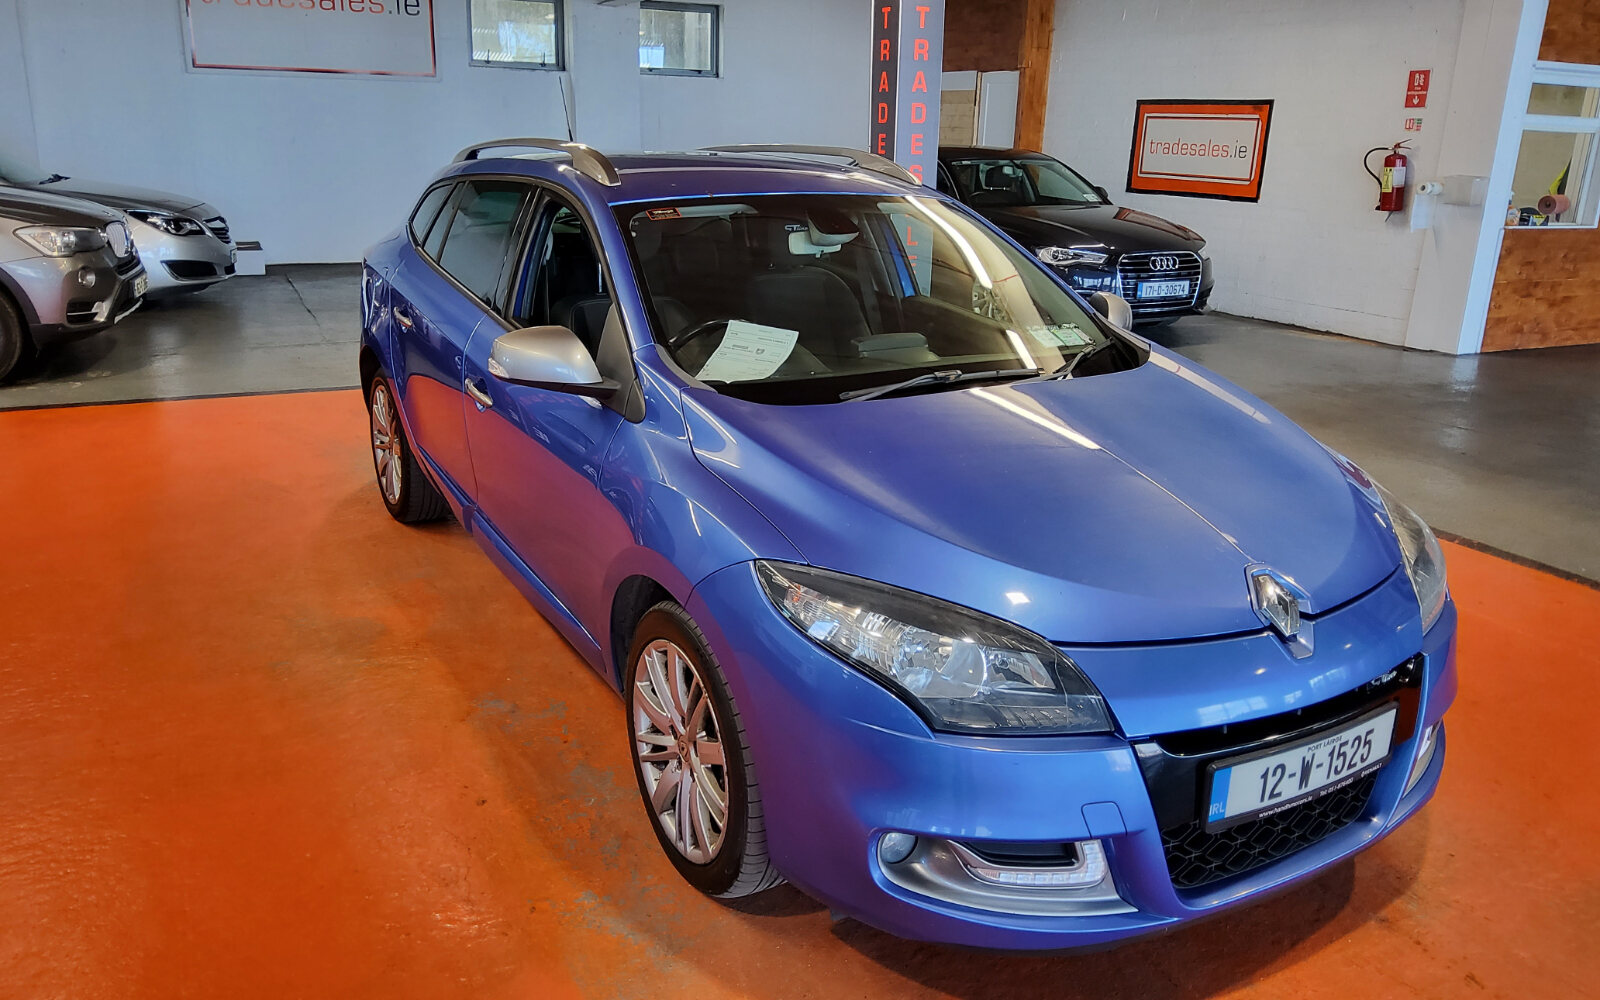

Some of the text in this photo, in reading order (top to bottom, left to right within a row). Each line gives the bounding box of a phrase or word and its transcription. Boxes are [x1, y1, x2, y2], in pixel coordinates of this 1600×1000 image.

[203, 0, 421, 16] sales.ie
[1149, 137, 1248, 159] tradesales.ie
[1259, 728, 1375, 803] 12-W-1525
[1208, 801, 1224, 816] IRL
